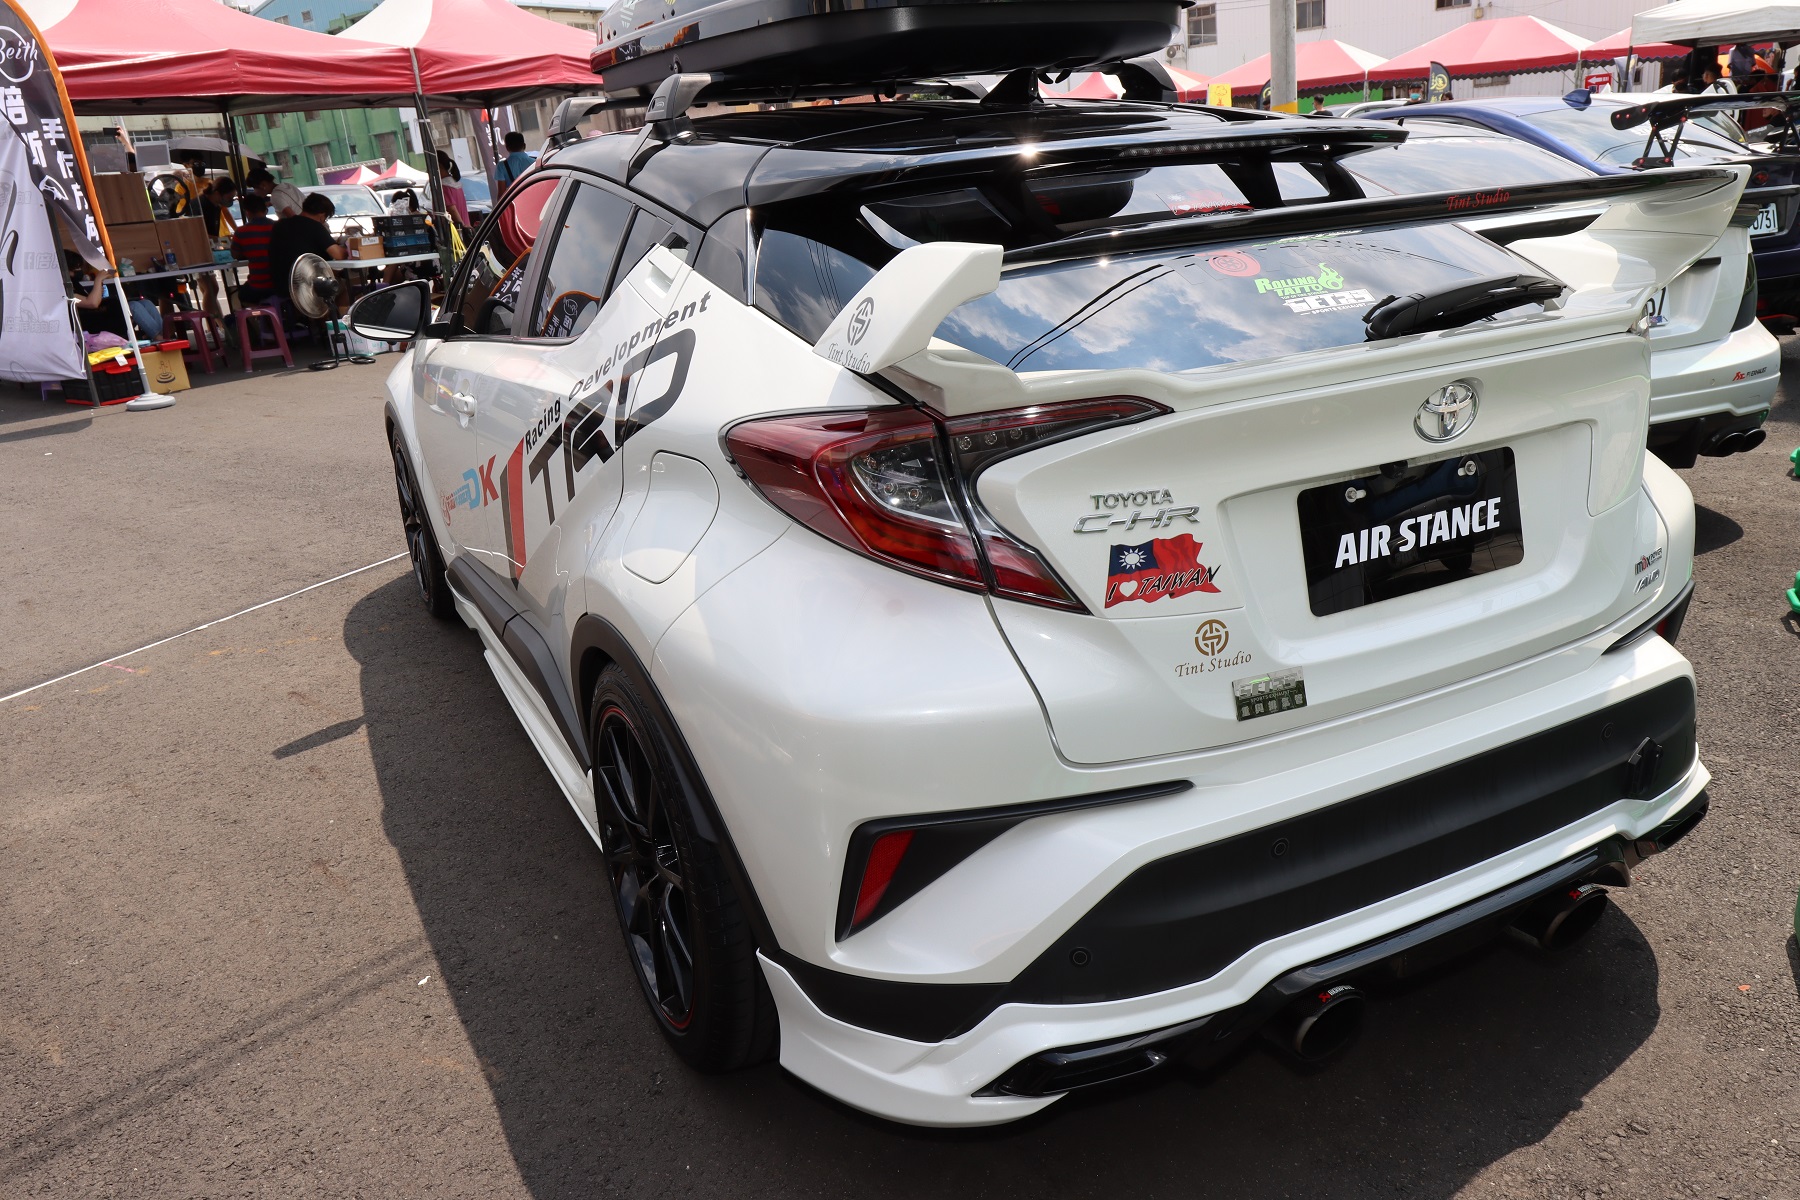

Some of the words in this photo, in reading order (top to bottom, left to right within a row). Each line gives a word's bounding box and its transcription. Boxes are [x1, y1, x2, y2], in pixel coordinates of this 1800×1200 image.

[1446, 194, 1472, 211] Tint
[1472, 187, 1511, 208] Studio
[525, 397, 561, 455] Racing
[568, 289, 711, 401] Development
[828, 343, 844, 363] Tint
[842, 350, 871, 374] Studio
[529, 328, 696, 526] TRD
[1090, 488, 1173, 510] TOYOTA
[1073, 505, 1201, 533] C-HR
[1335, 525, 1391, 568] AIR
[1399, 497, 1501, 552] STANCE
[1138, 565, 1222, 597] TAIWAN
[1175, 661, 1205, 677] Tint
[1207, 650, 1252, 673] Studio
